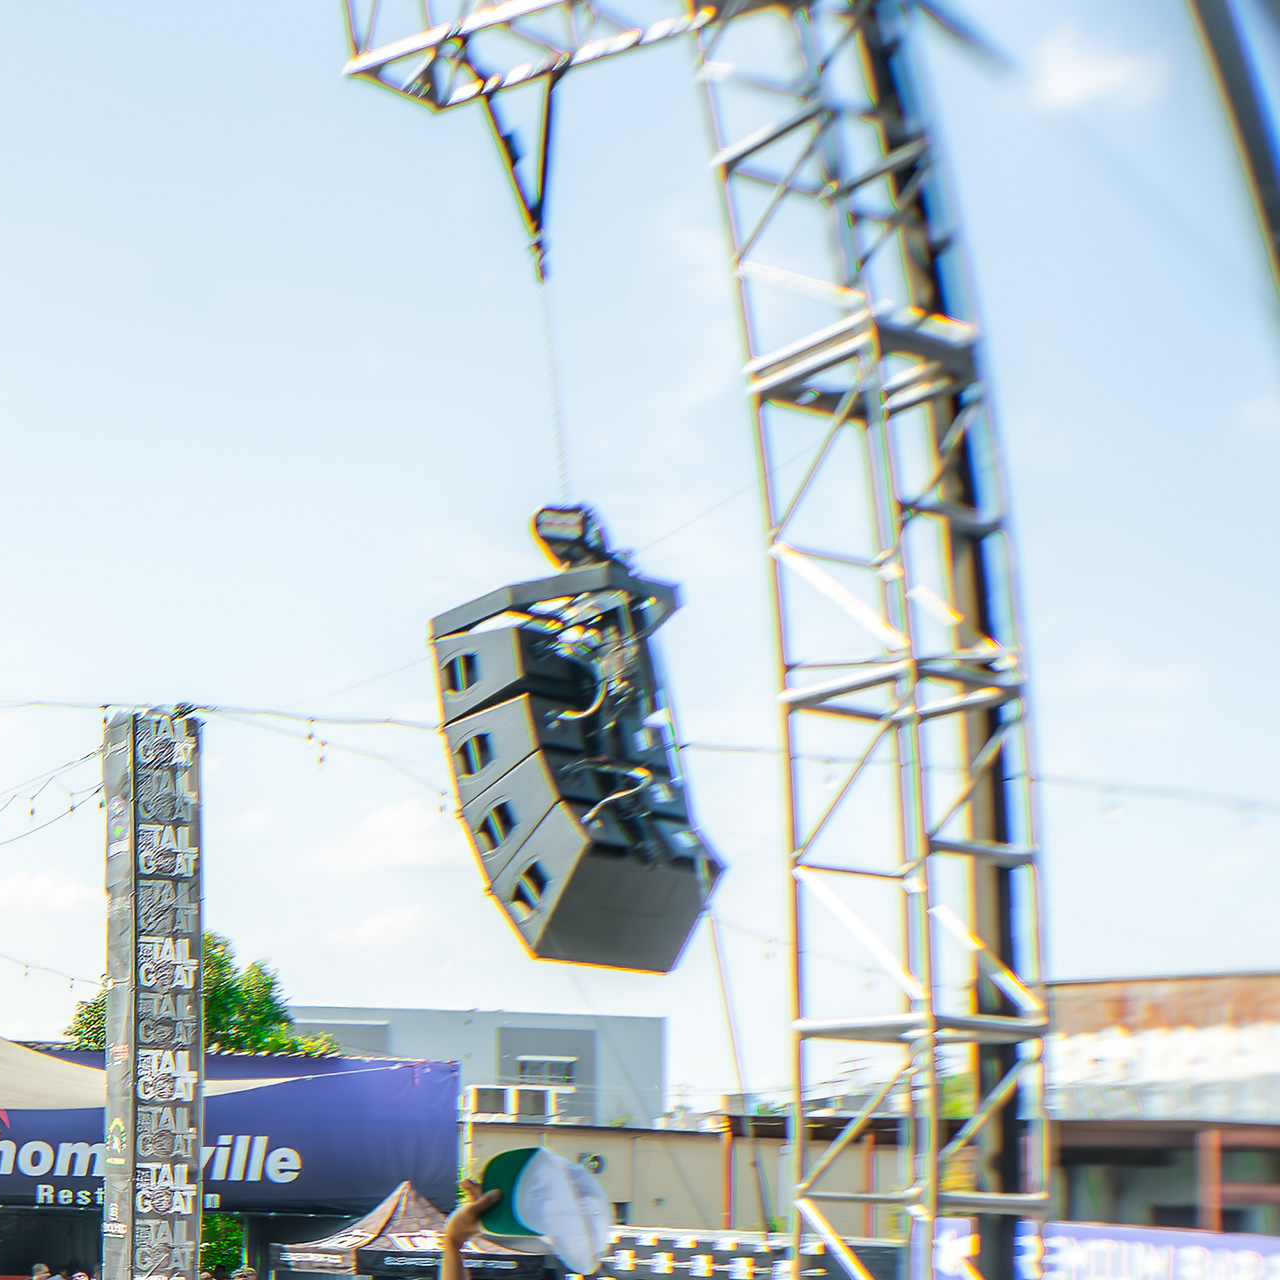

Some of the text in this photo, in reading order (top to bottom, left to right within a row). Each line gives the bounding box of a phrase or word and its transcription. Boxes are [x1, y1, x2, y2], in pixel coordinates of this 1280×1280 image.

[139, 824, 198, 856] TAIL
[139, 936, 198, 968] TAIL
[139, 993, 197, 1022] TAIL
[138, 1050, 198, 1082] TAIL
[137, 1106, 197, 1138] TAIL
[136, 1163, 197, 1195] TAIL
[136, 1219, 195, 1250] TAIL
